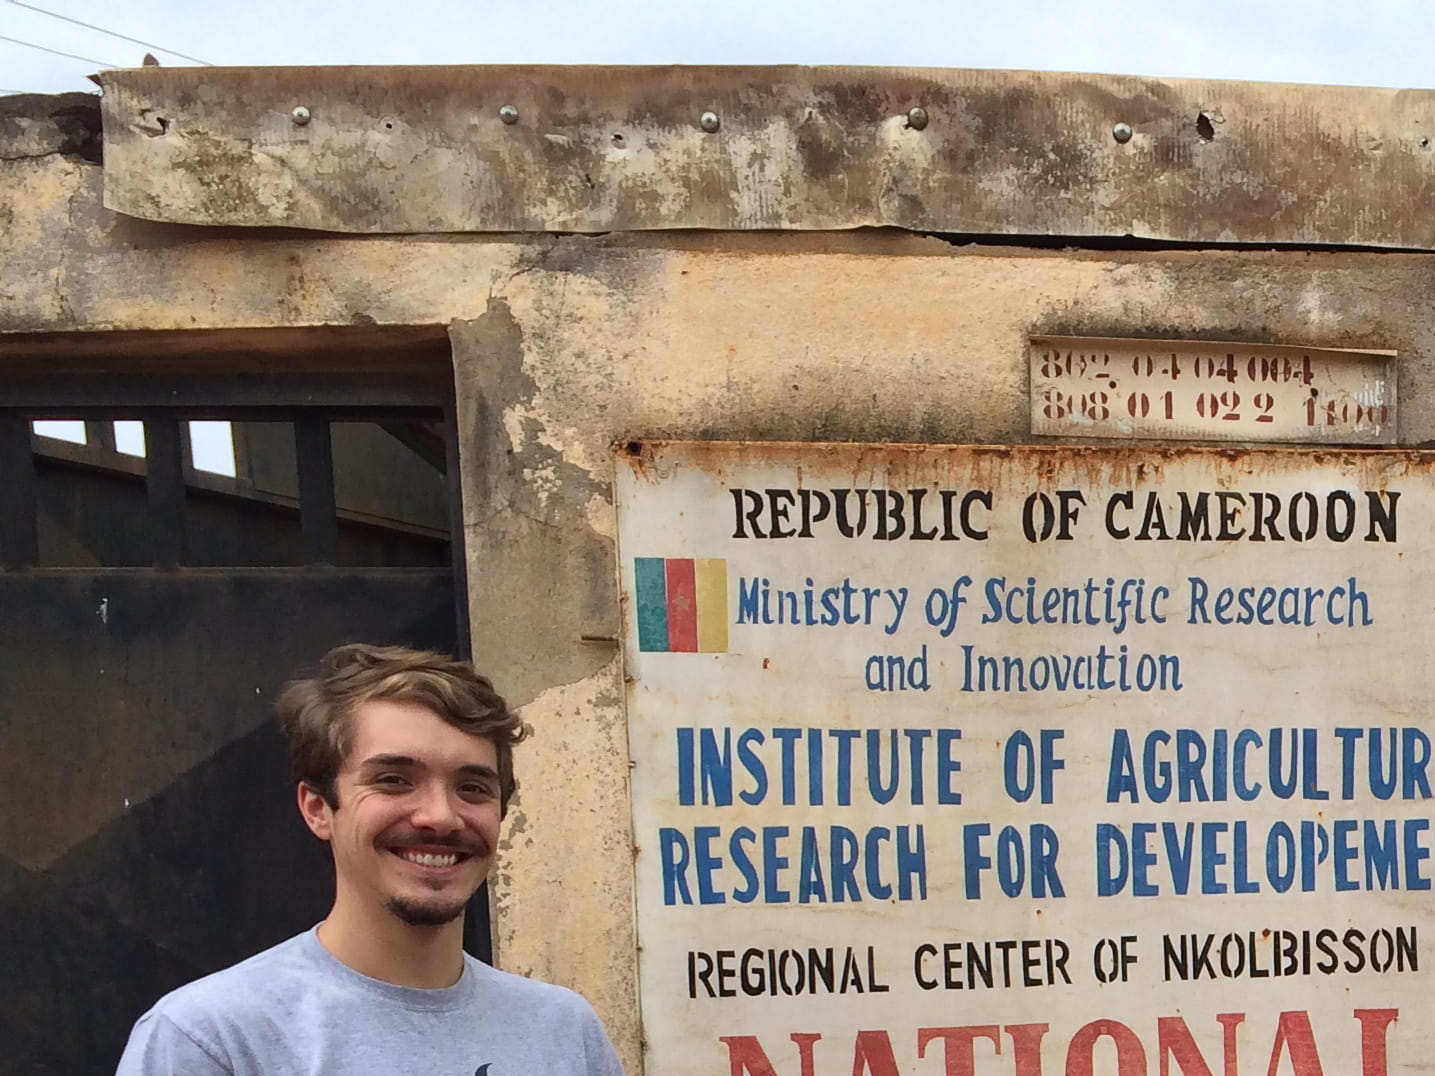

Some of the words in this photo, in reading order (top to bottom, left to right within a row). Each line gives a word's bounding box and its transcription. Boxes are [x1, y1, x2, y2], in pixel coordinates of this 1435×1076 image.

[729, 488, 993, 541] REPUBLIC
[1022, 490, 1087, 542] OF
[1105, 490, 1401, 542] CAMEROON
[736, 577, 908, 635] Ministry
[925, 576, 972, 636] of
[982, 576, 1169, 634] Scientific
[1187, 577, 1374, 627] Research
[865, 644, 931, 691] and
[960, 644, 1183, 691] Innovation
[676, 728, 962, 807] INSTITUTE
[1004, 729, 1065, 805] OF
[659, 824, 927, 905] RESEARCH
[963, 823, 1066, 899] FOR
[687, 946, 889, 998] REGIONAL
[914, 939, 1072, 990] CENTER
[1094, 936, 1138, 983] OF
[1163, 926, 1419, 981] NKOLBISSON
